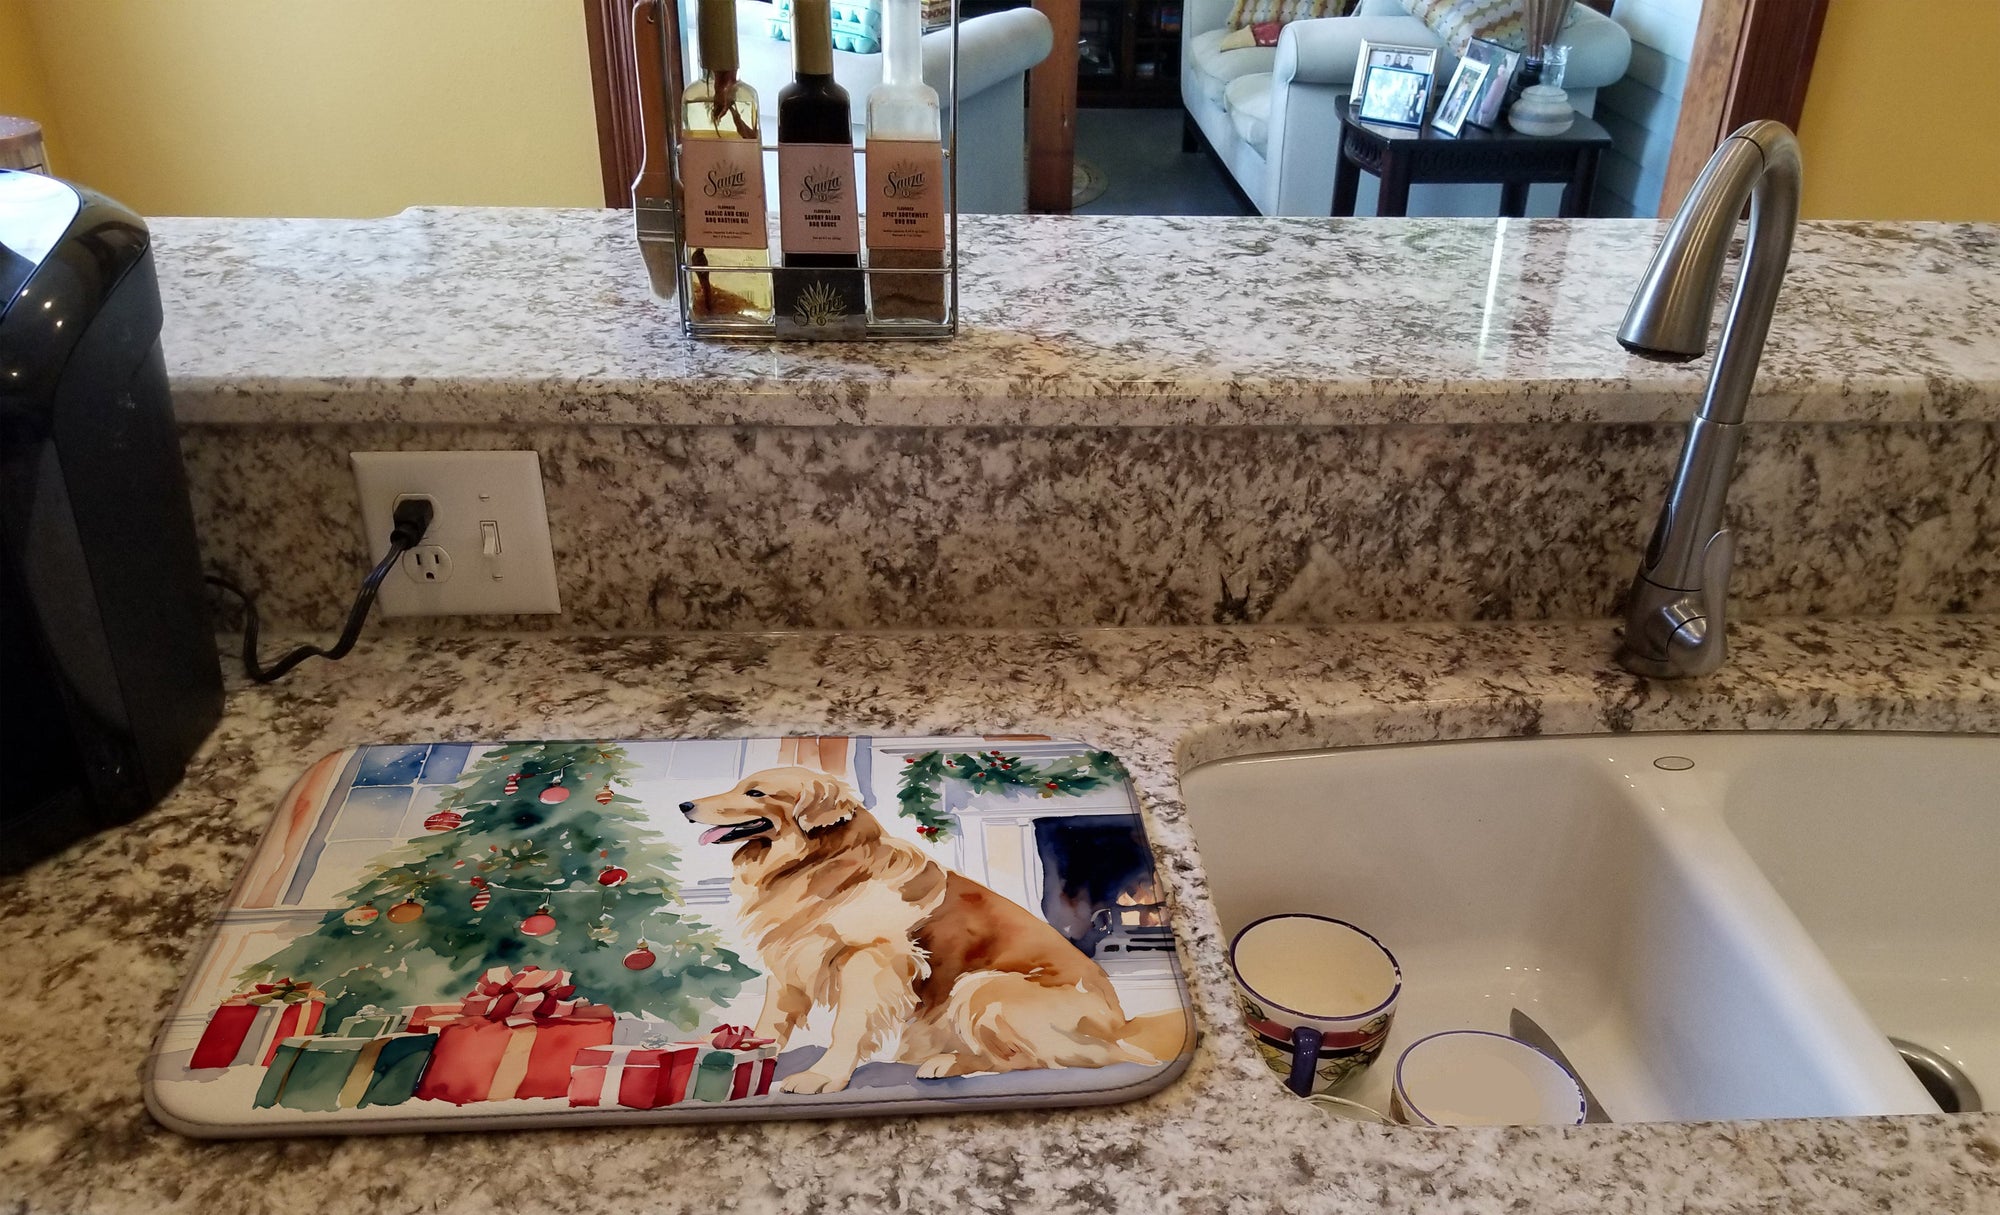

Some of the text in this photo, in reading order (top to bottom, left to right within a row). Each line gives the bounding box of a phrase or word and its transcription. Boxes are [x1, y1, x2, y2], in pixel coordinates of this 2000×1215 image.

[703, 170, 744, 197] Sauza
[799, 175, 840, 202] Sauza
[883, 171, 923, 198] Sauza
